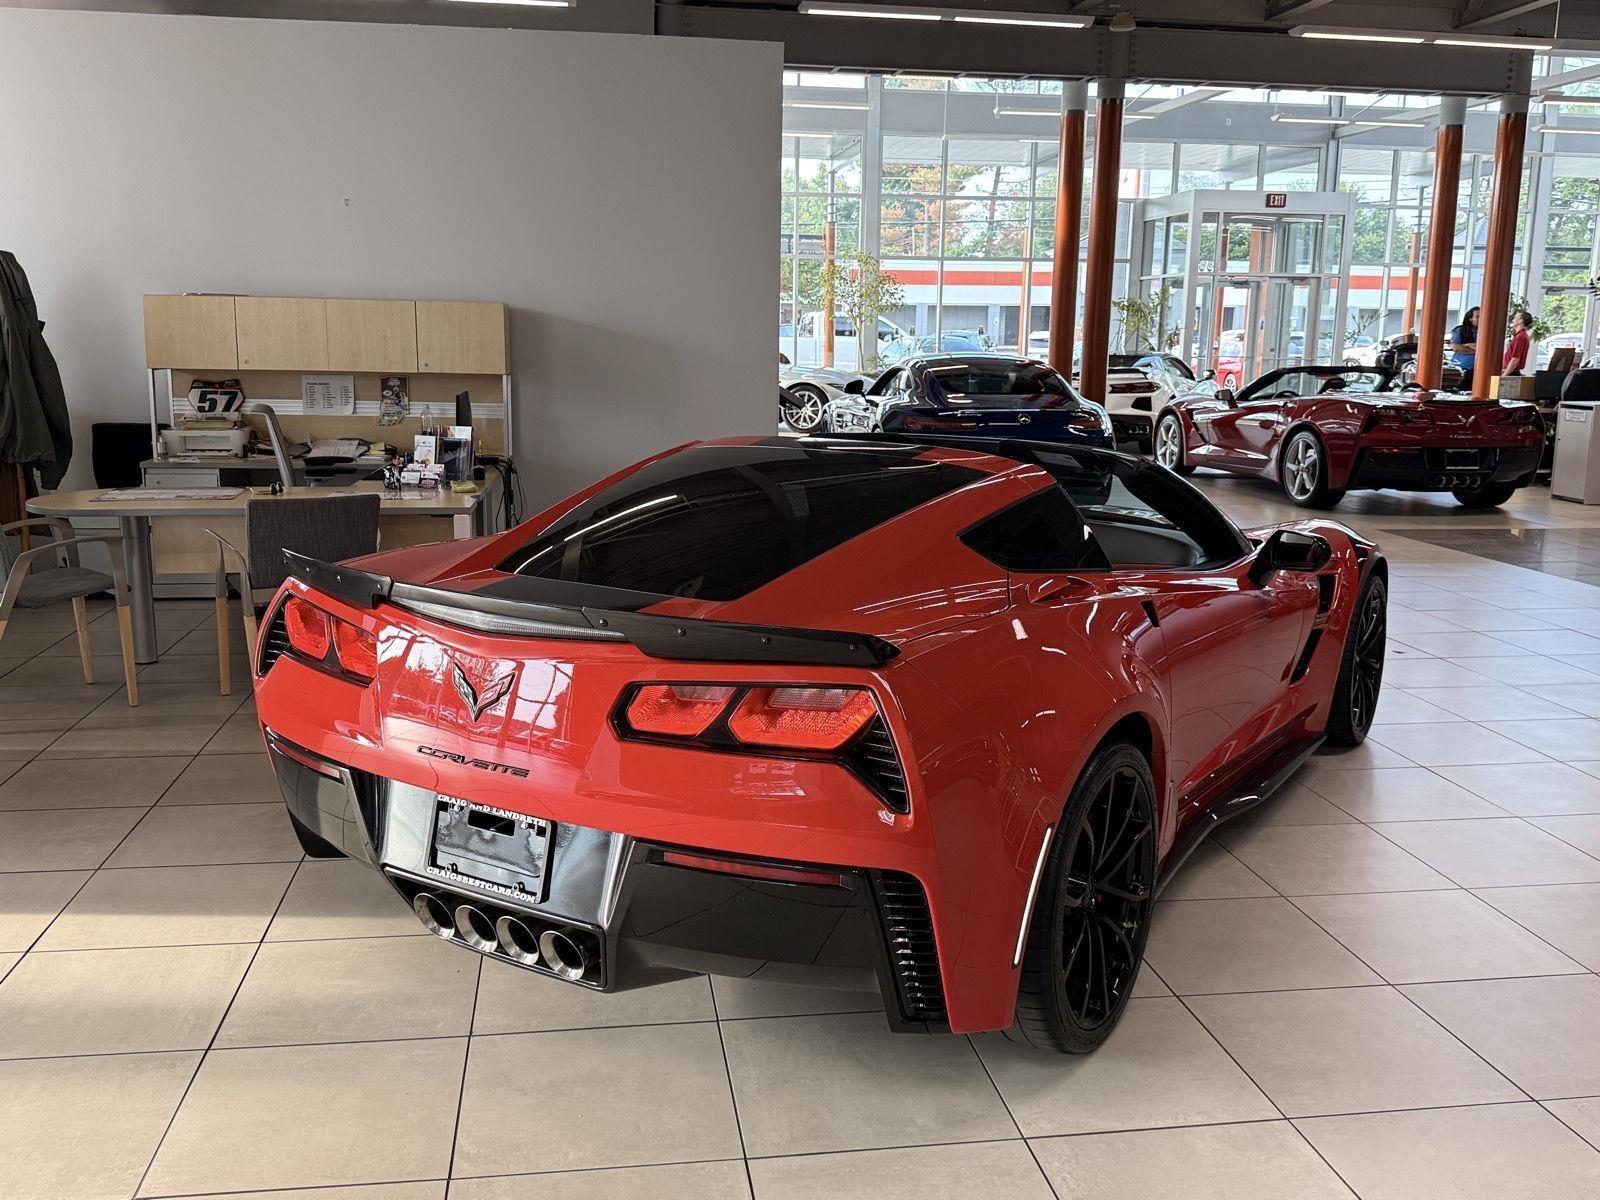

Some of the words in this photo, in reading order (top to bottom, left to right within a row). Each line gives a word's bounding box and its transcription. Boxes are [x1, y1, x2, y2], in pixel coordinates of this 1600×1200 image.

[1270, 194, 1285, 206] EXIT
[197, 390, 238, 412] 57
[416, 745, 530, 778] CORVETTE
[438, 794, 467, 807] CRAIG
[492, 806, 547, 826] LANDRETH
[426, 866, 535, 903] CRAIGSBESTCARS.COM
